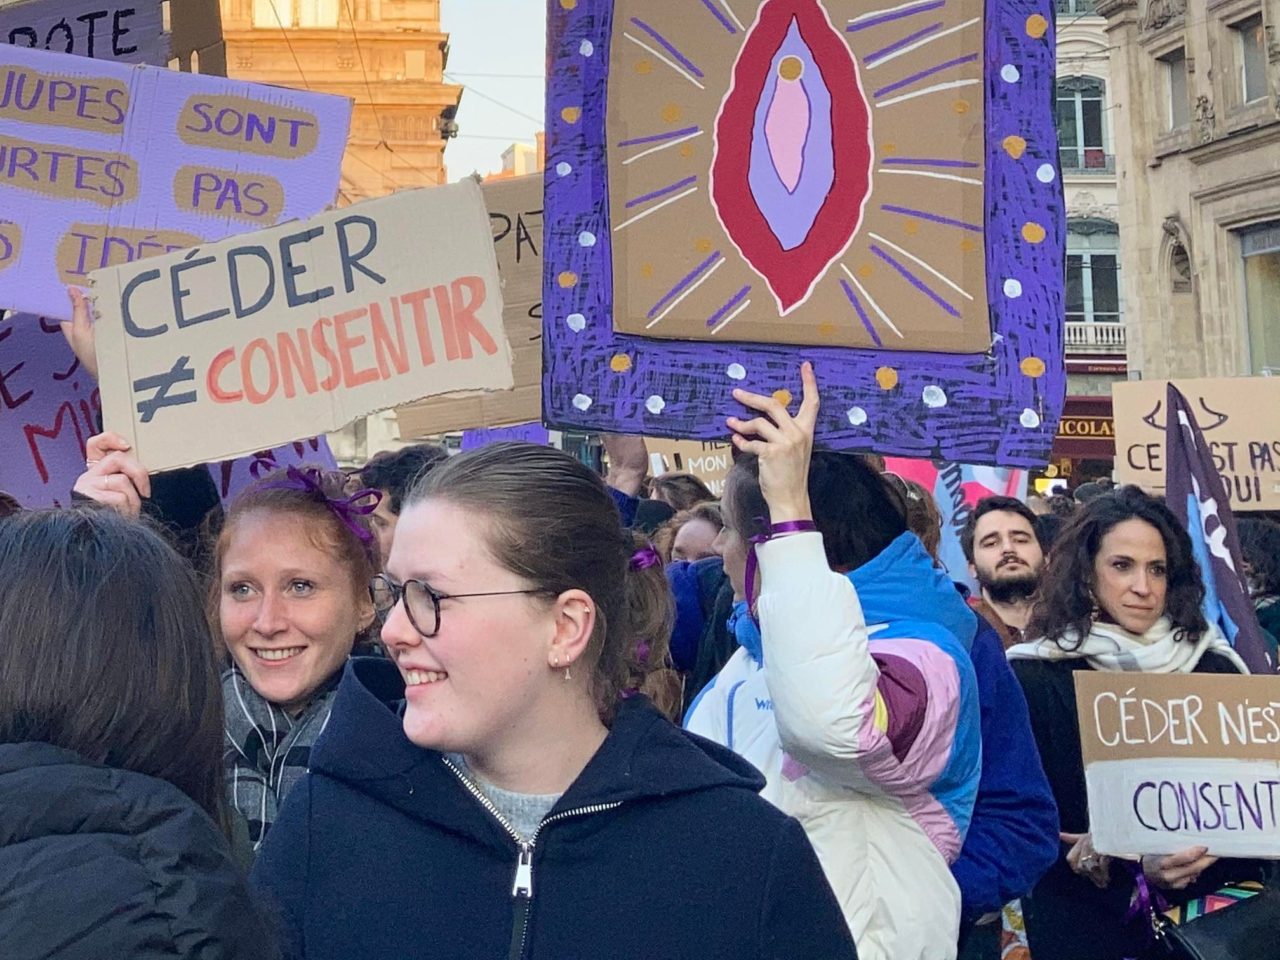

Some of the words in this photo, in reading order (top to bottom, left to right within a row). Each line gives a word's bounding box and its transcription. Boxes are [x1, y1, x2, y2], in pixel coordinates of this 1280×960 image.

[184, 102, 314, 149] SONT
[191, 173, 269, 217] PAS
[122, 215, 387, 339] CÉDER
[206, 276, 498, 405] CONSENTIR
[1059, 420, 1115, 435] ICOLA
[688, 454, 727, 475] MON
[1127, 443, 1163, 472] CE
[1093, 687, 1208, 746] CÉDER
